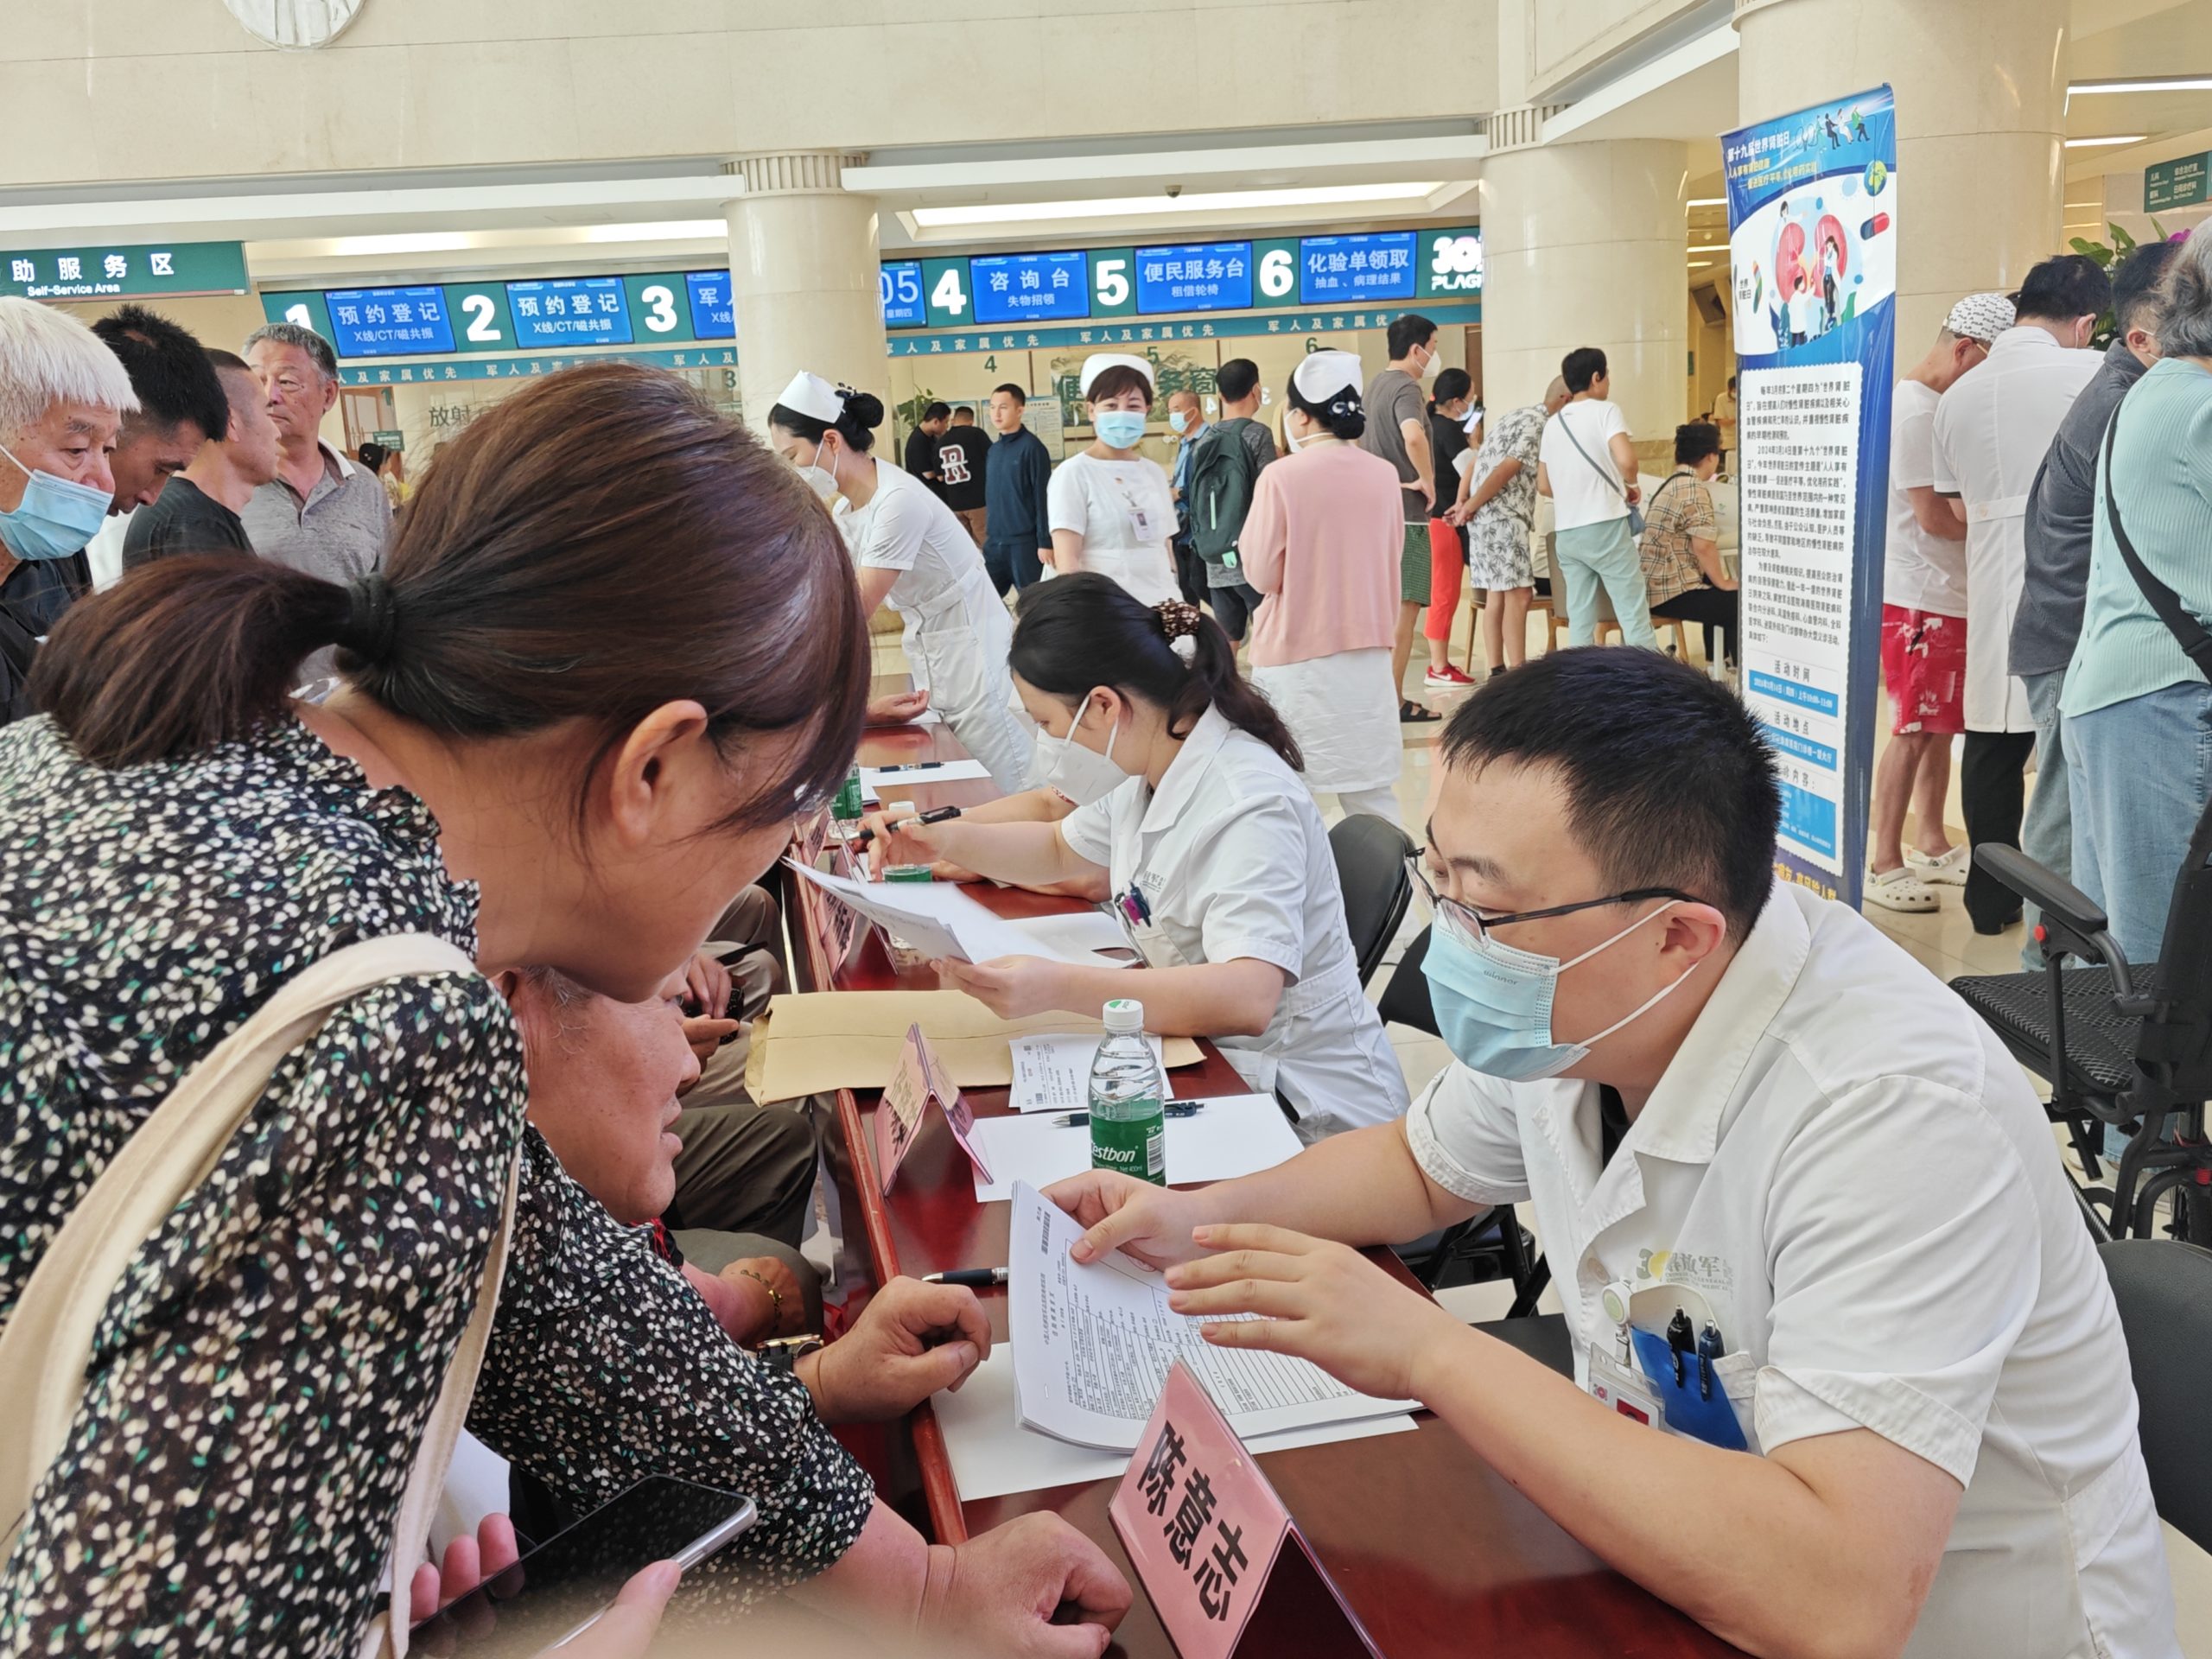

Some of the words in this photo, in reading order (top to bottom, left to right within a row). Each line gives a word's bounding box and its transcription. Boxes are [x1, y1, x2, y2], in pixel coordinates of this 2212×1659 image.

[12, 253, 174, 283] 助服务区
[1144, 257, 1244, 283] 便民服务台
[1307, 249, 1409, 274] 化验单领取
[990, 268, 1071, 292] 咨询台
[1096, 259, 1129, 306] 5
[1260, 249, 1294, 297] 6
[27, 283, 92, 297] Self-Service
[94, 283, 120, 294] Area
[931, 269, 967, 315] 4
[1007, 293, 1055, 308] 失物招领
[1171, 283, 1219, 298] 租借轮椅
[337, 302, 441, 326] 预约登记
[518, 294, 620, 318] 预约登记
[642, 285, 677, 333] 3
[887, 308, 913, 319] 星期四
[462, 294, 502, 342] 2
[532, 318, 613, 334] X线/CT/磁共振
[1268, 313, 1406, 333] 军人及家属优
[353, 327, 434, 343] X线/CT/磁共振
[1081, 323, 1215, 344] 军人及家属优先
[674, 352, 734, 366] 军人及
[984, 354, 997, 372] 4
[1147, 346, 1160, 365] 5
[724, 370, 736, 389] 3
[381, 387, 391, 406] 1
[1092, 1141, 1136, 1163] estbon
[1136, 1419, 1249, 1622] 陈意志
